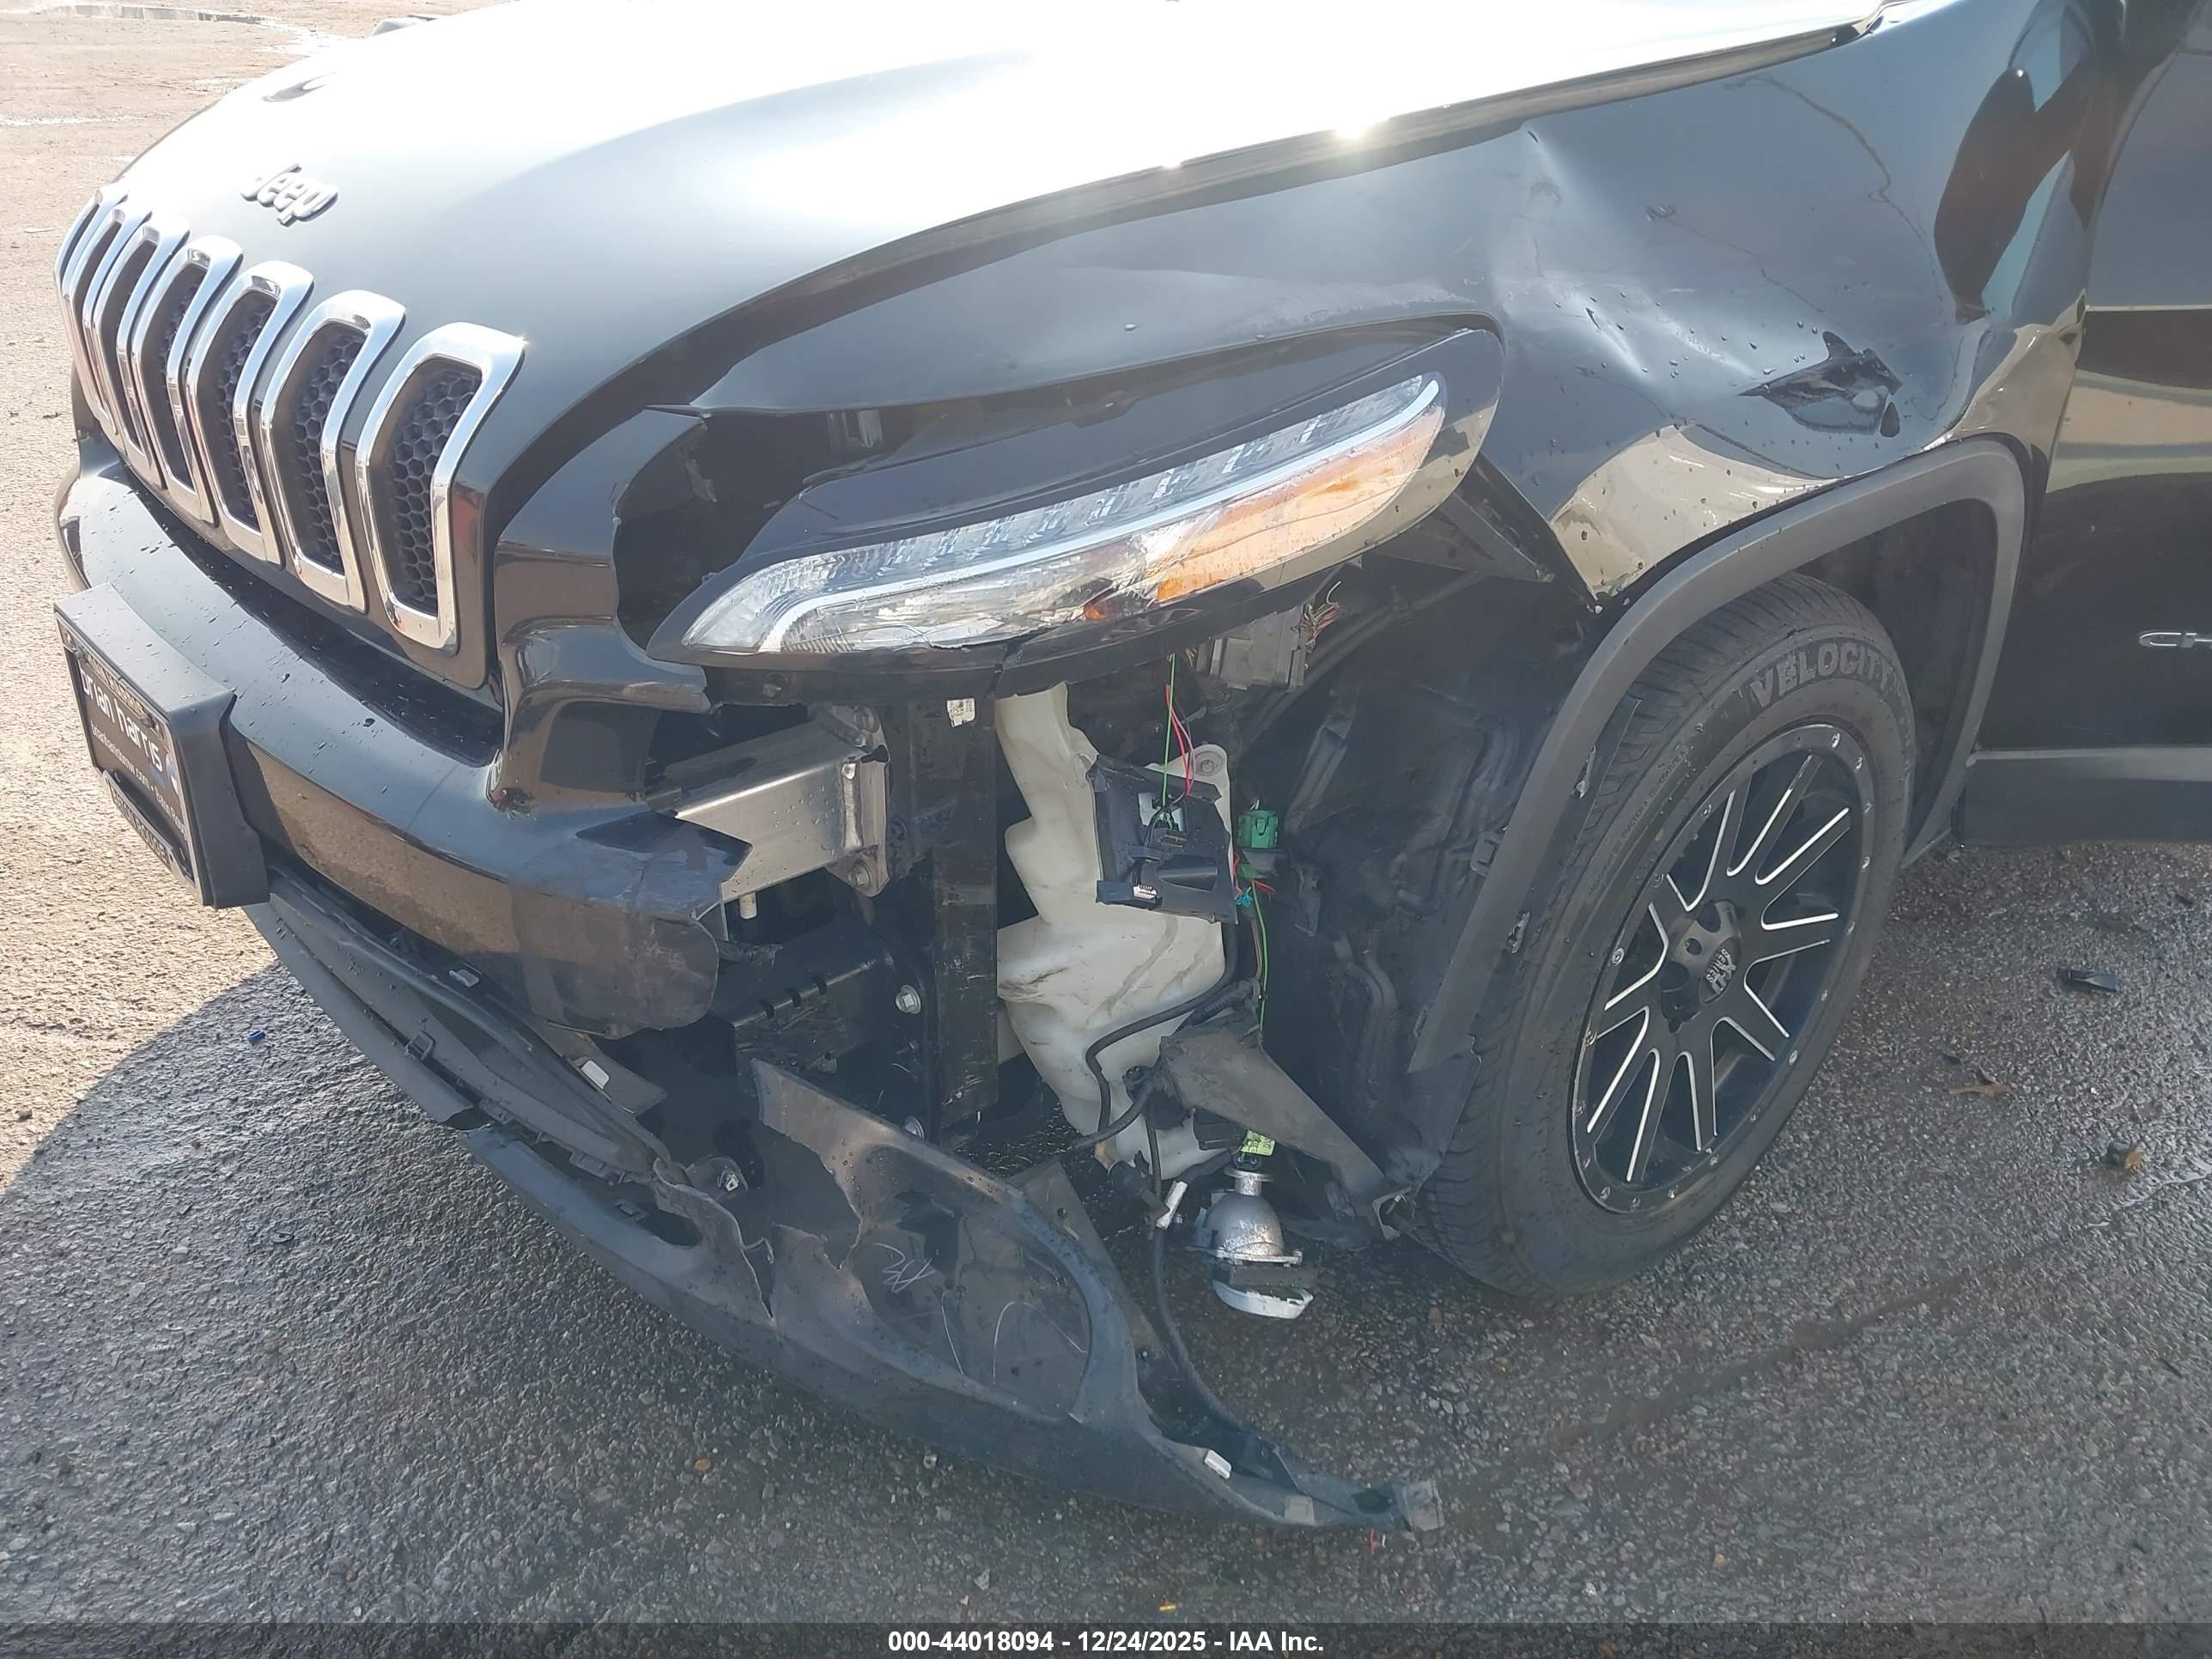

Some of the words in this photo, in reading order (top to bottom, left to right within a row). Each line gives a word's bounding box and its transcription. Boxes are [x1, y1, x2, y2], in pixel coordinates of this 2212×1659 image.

[240, 163, 338, 228] Jeep
[1750, 642, 1893, 708] VELOCITY
[78, 661, 115, 723] brian
[113, 698, 163, 773] harris
[170, 806, 187, 842] Roug
[1705, 948, 1731, 983] SERIES
